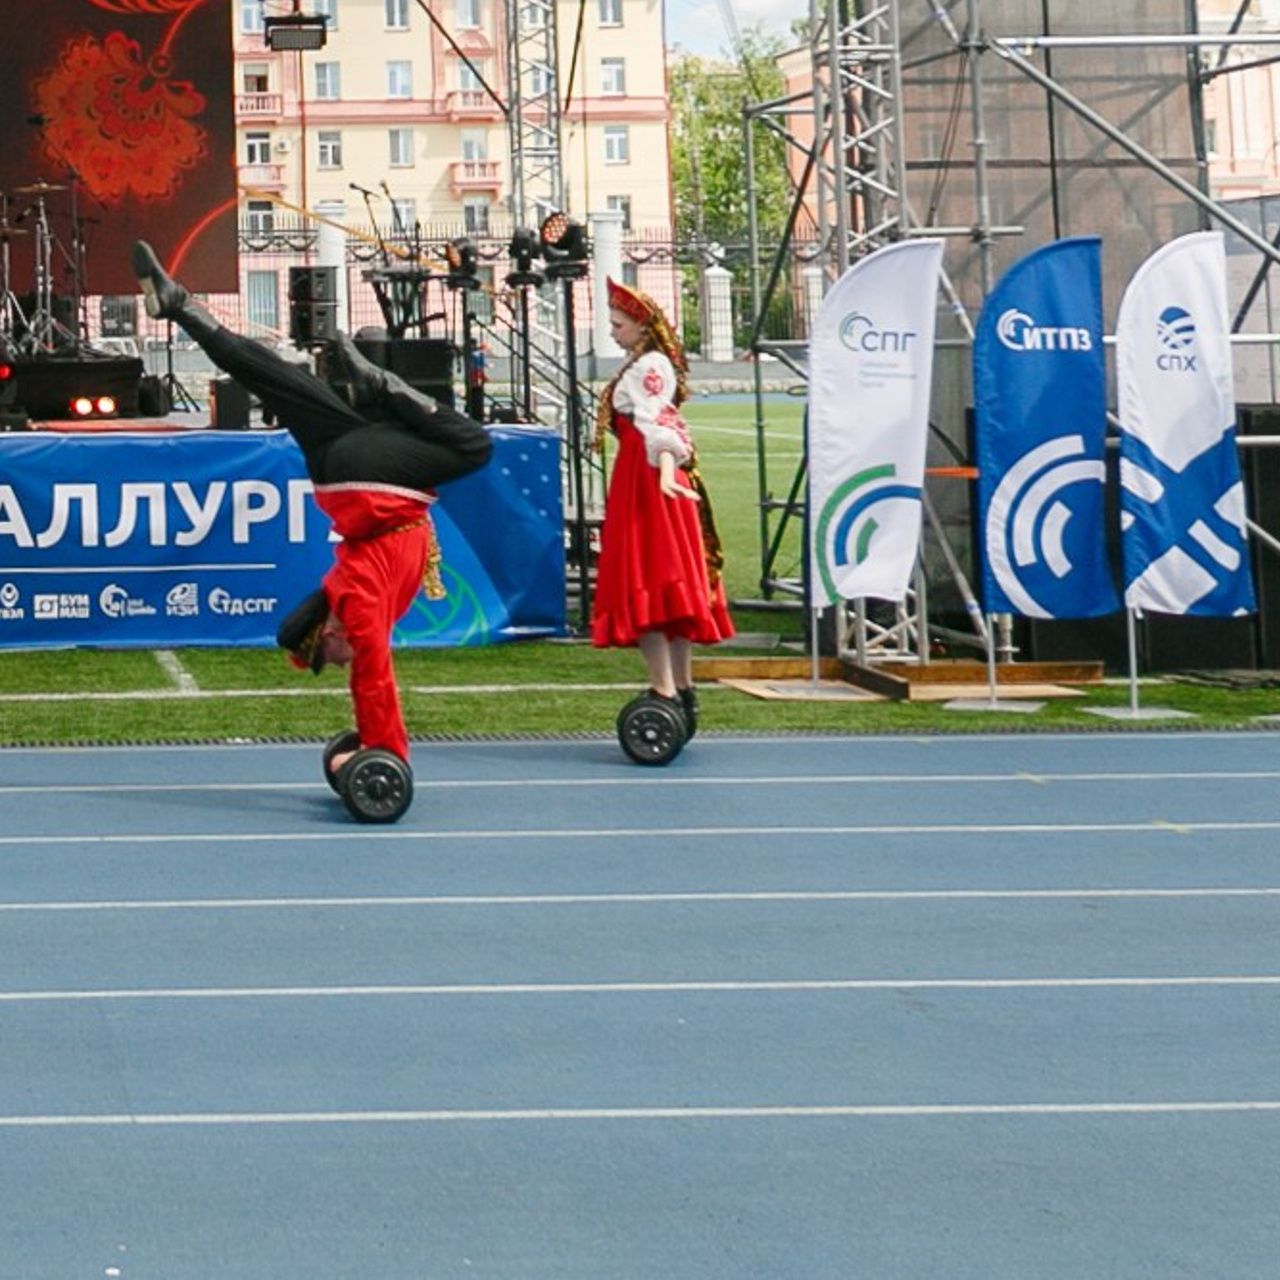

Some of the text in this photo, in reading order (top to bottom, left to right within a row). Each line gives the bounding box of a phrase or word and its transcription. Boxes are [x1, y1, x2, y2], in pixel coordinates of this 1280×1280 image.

[861, 331, 917, 352] СПГ
[1022, 327, 1092, 351] ИТПЗ
[1156, 353, 1197, 372] СПХ
